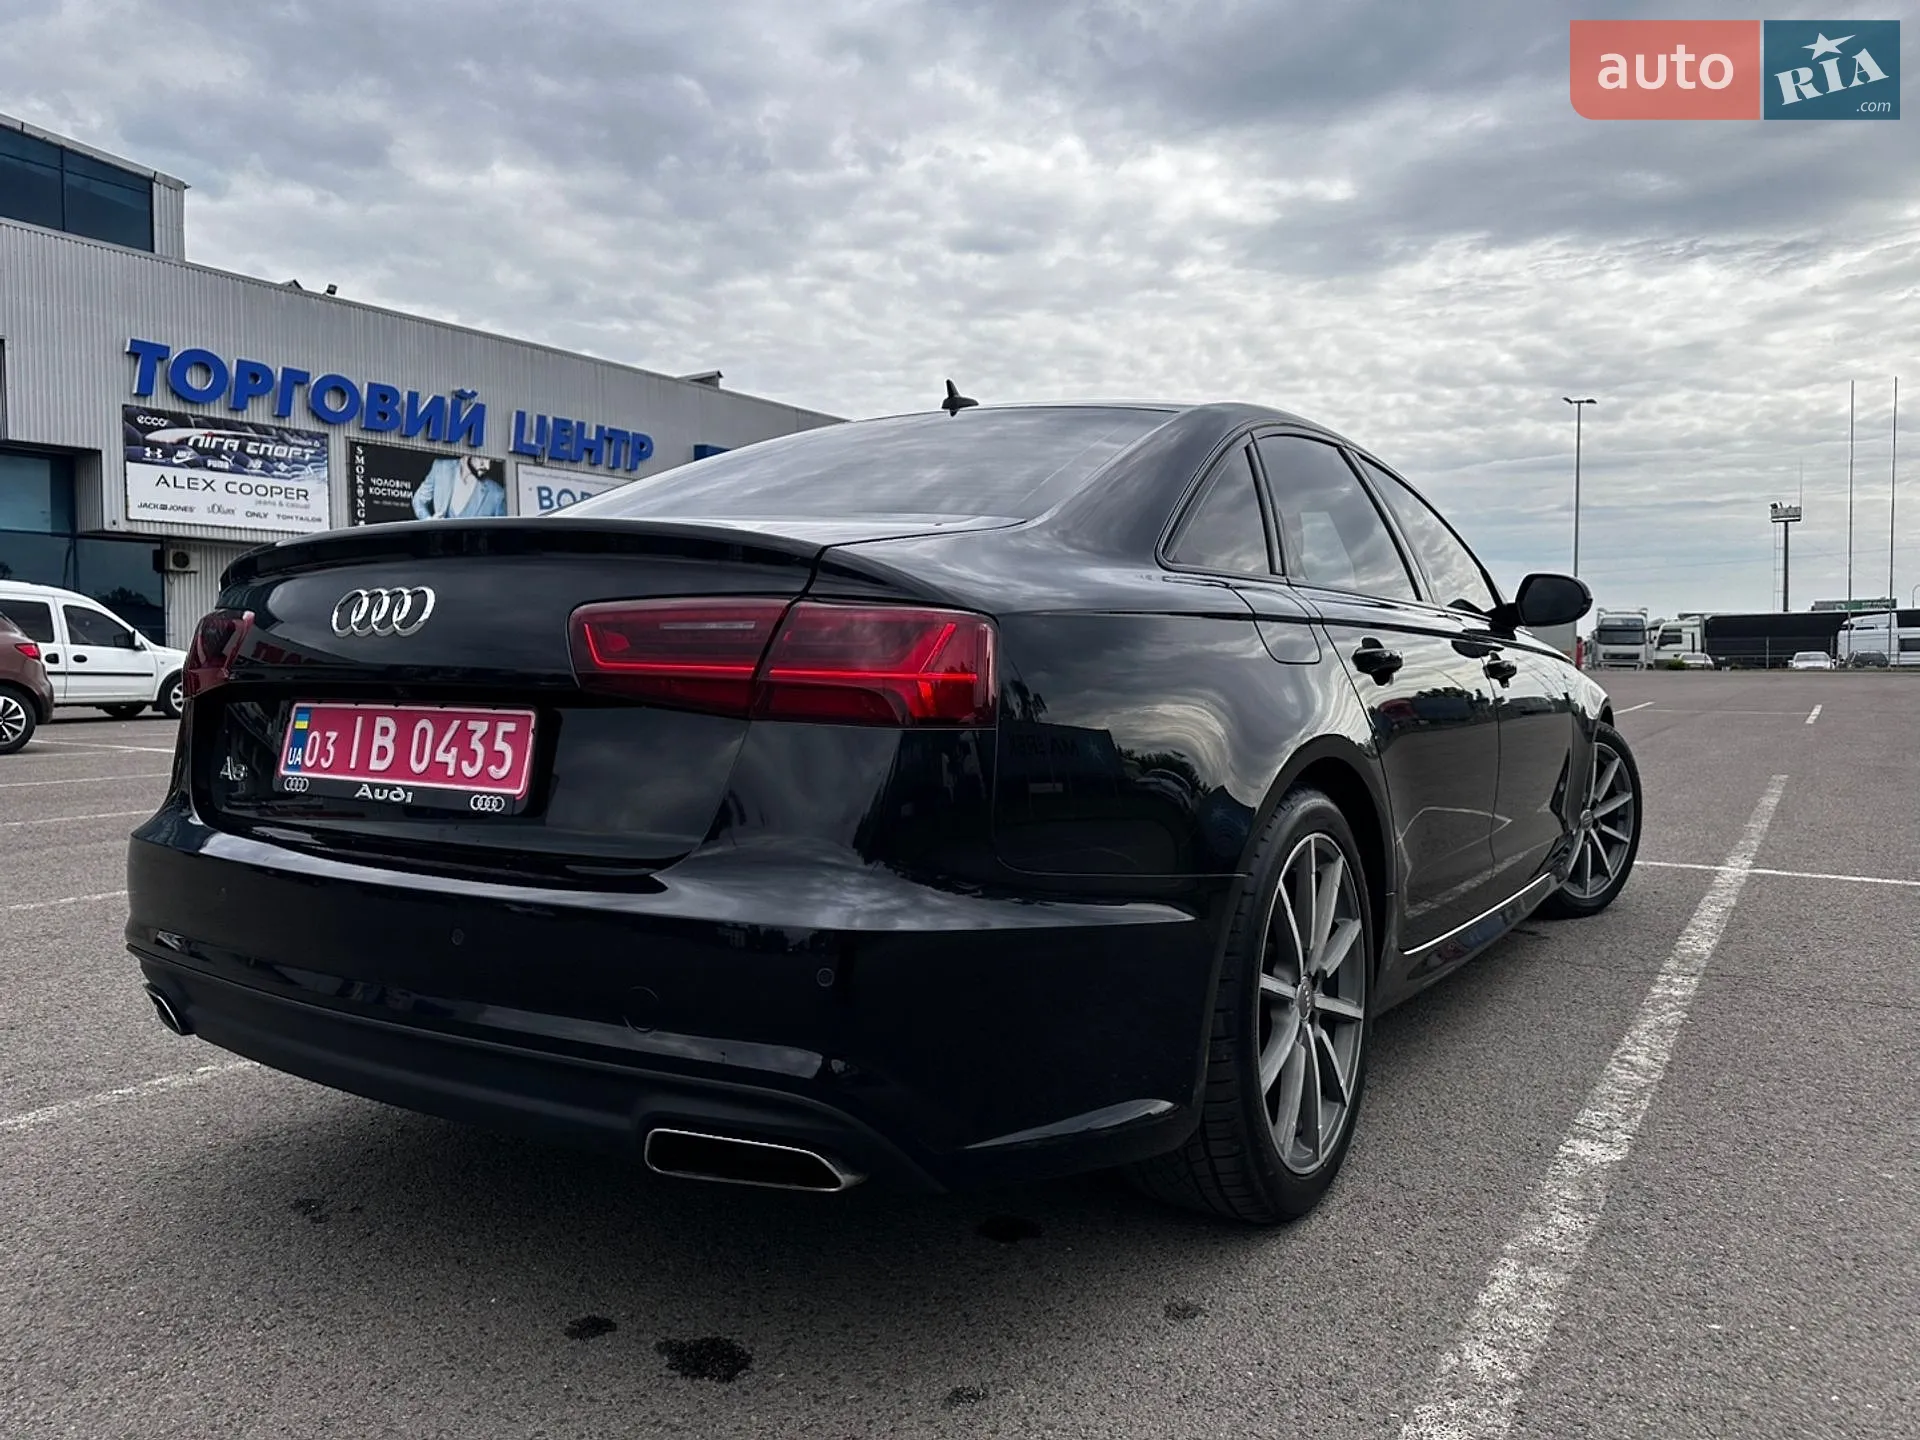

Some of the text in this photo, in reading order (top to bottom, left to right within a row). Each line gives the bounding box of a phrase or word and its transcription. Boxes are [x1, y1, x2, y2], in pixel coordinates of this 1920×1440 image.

[126, 338, 654, 472] ТОРГОВИЙ ЦЕНТР
[137, 415, 168, 427] ecco
[155, 474, 309, 501] ALEX COOPER
[369, 487, 413, 499] КОСТЮМИ
[287, 747, 302, 765] UA
[304, 731, 338, 768] 03
[410, 718, 516, 780] 0435
[354, 784, 413, 803] Audi
